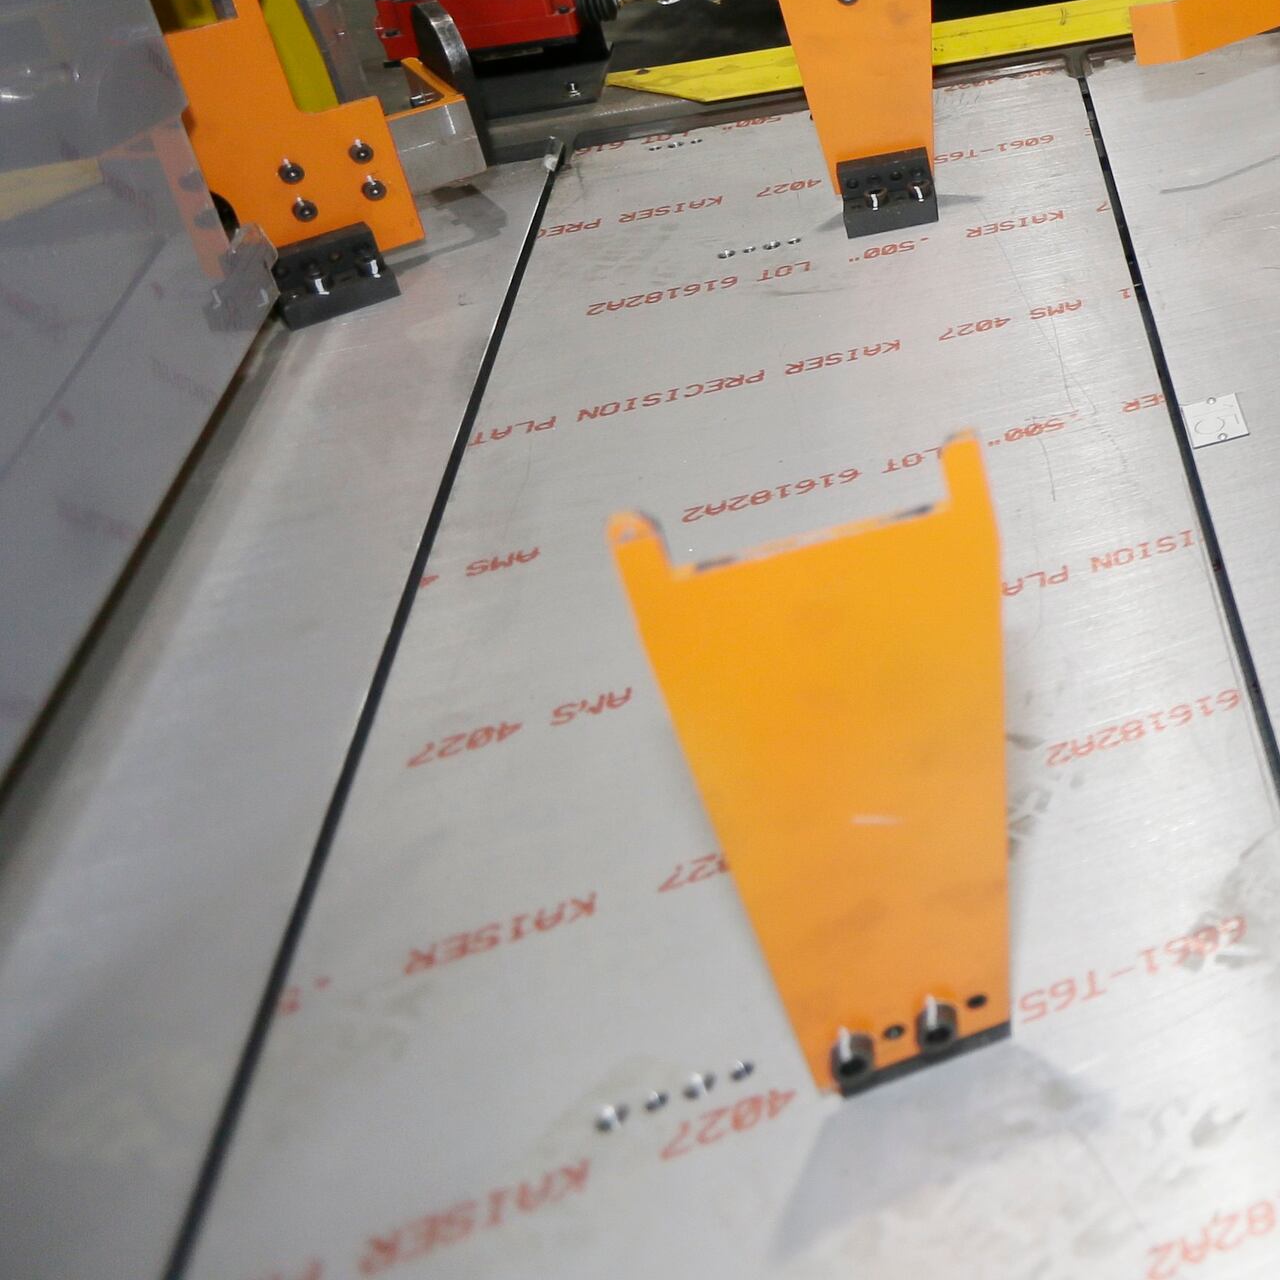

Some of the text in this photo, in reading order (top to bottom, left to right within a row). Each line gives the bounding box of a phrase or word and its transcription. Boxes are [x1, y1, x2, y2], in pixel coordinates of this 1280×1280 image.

[616, 194, 725, 224] KAISER
[754, 177, 823, 199] 4027
[964, 209, 1066, 239] KAISER
[755, 260, 813, 283] LOT
[584, 274, 740, 318] 616182A2
[466, 298, 1086, 450] AMS 4027 KAISER PRECISION PLAT
[680, 466, 864, 525] 616182A2
[464, 545, 542, 578] AMS
[548, 686, 634, 728] AMS
[1044, 686, 1244, 769] 616182A2
[405, 720, 524, 770] 4027
[401, 891, 599, 978] KAISER
[657, 1085, 796, 1163] 4027
[356, 1156, 591, 1276] KAISER
